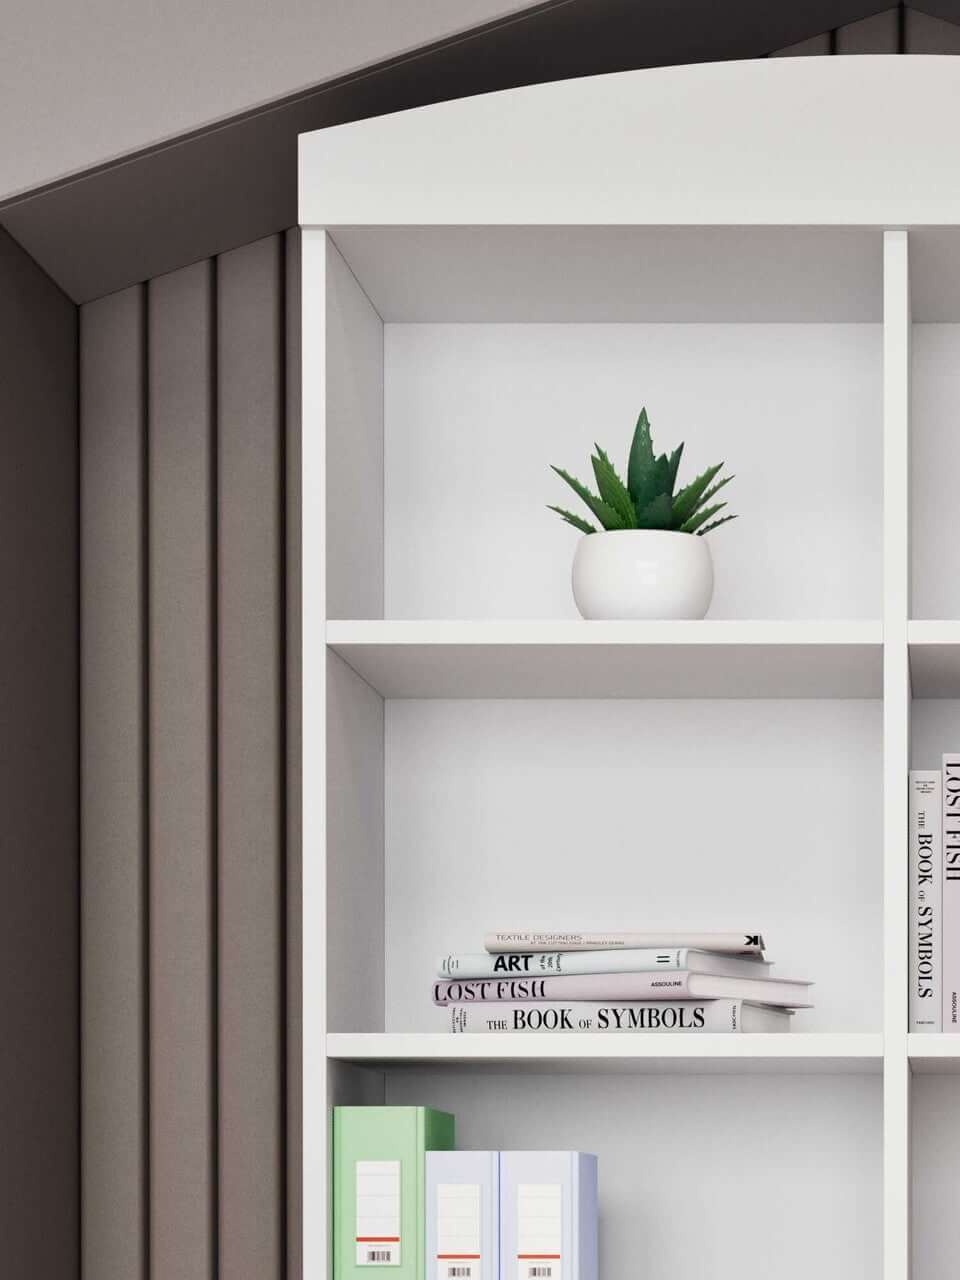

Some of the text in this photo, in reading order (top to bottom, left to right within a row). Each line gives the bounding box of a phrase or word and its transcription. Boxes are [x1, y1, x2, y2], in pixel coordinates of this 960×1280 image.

[918, 834, 933, 886] BOOK
[493, 955, 534, 972] ART
[918, 906, 933, 999] SYMBOLS
[435, 981, 546, 1001] LOST FISH
[487, 1007, 705, 1030] THE BOOK OF SYMBOLS
